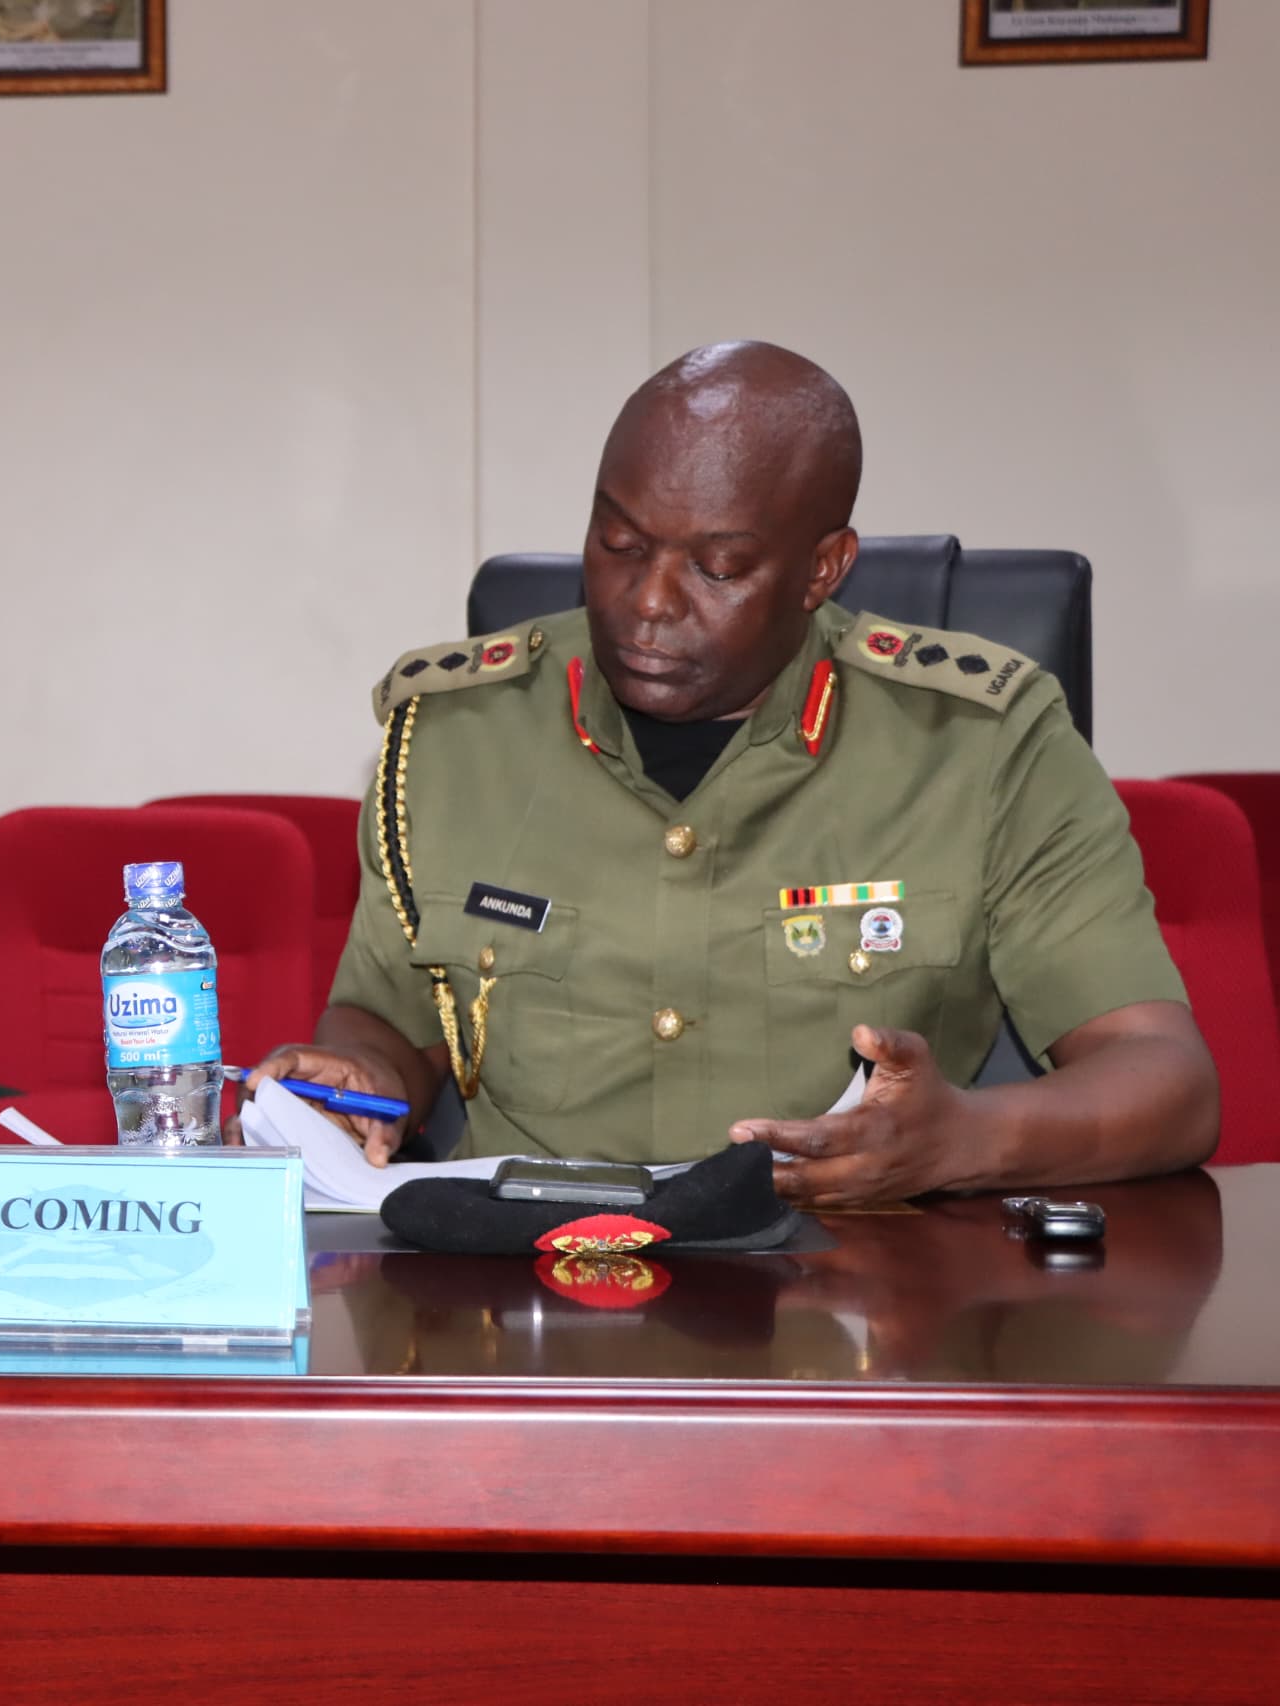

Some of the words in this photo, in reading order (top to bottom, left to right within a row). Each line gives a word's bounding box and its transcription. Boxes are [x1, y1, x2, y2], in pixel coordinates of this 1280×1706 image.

[986, 658, 1024, 696] UGANDA
[479, 895, 532, 919] ANKUNDA
[109, 992, 177, 1017] Uzima
[120, 1051, 140, 1063] 500
[143, 1050, 161, 1061] ml
